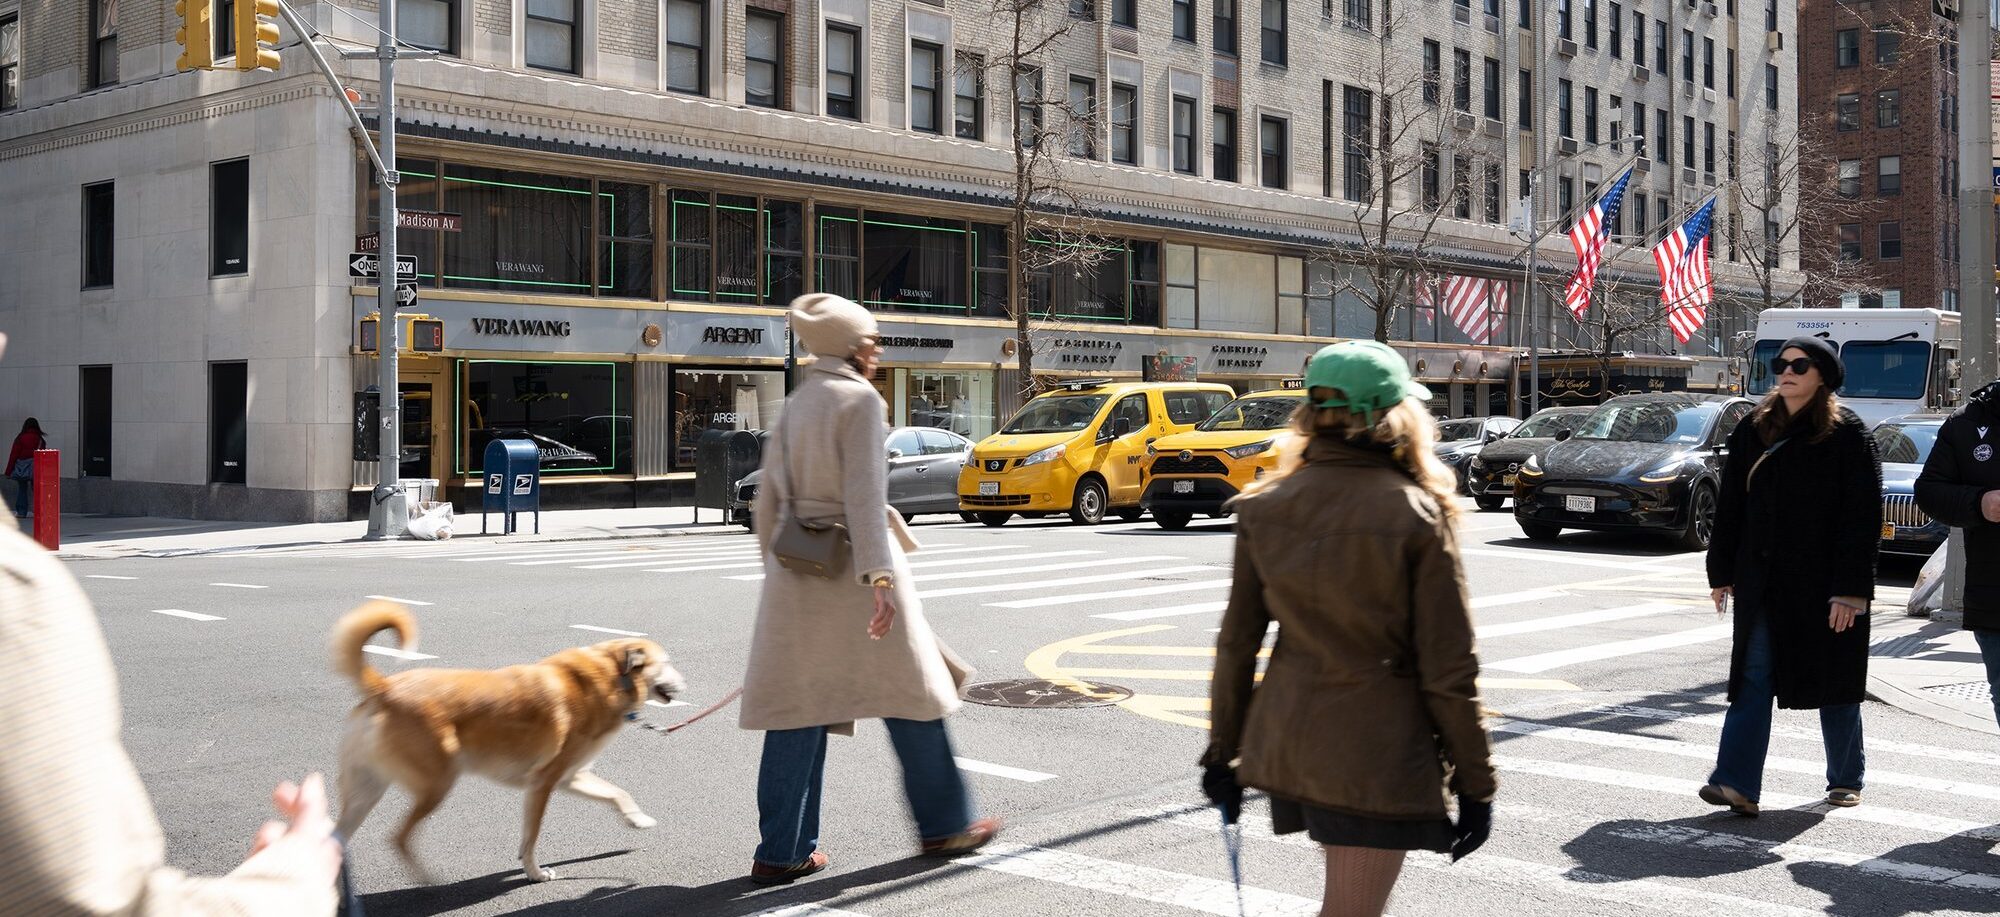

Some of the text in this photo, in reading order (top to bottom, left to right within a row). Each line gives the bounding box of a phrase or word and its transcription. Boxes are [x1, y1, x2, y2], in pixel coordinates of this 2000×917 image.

[399, 214, 455, 229] Madison Av
[360, 235, 379, 250] E 77 St
[358, 261, 411, 272] ONE AY
[1796, 321, 1831, 329] 7533554
[702, 326, 765, 344] ARGENT
[1054, 339, 1123, 350] GABRIELA
[1211, 344, 1268, 354] GABRIELA
[1062, 354, 1117, 364] HEARST
[1217, 358, 1263, 368] HEARST
